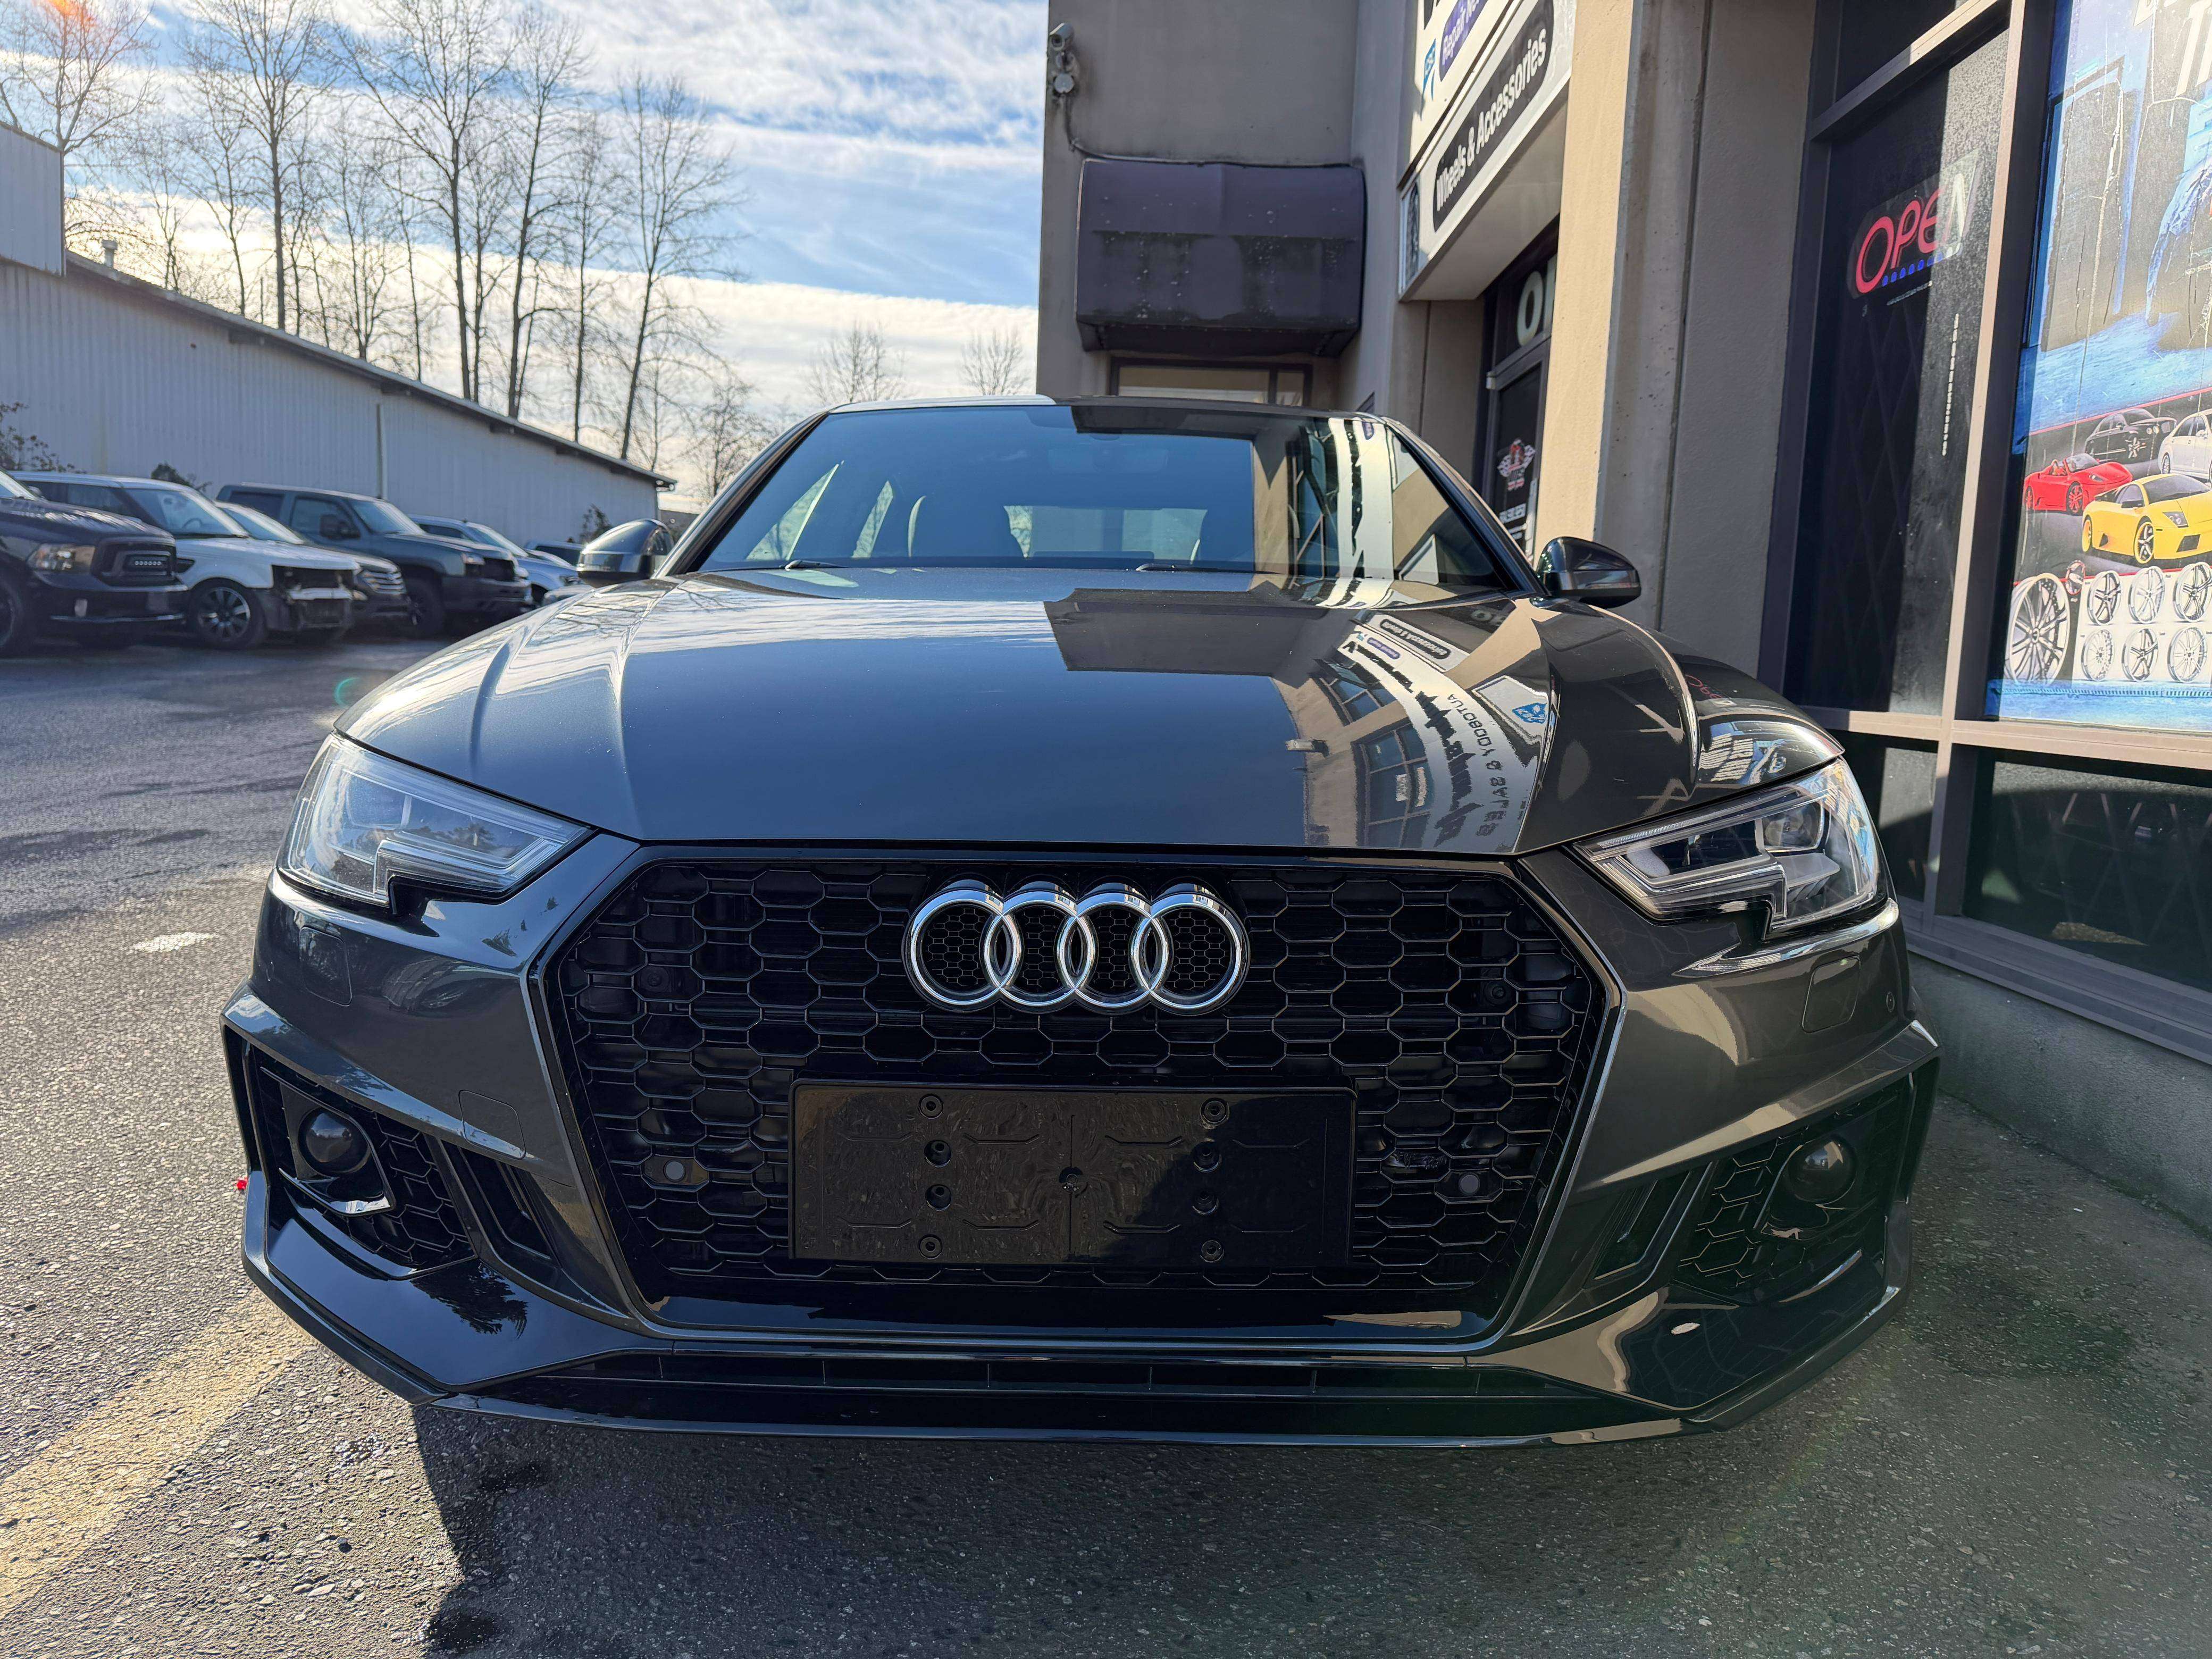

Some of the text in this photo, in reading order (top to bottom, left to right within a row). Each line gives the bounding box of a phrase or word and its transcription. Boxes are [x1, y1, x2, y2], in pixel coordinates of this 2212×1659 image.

[1437, 29, 1546, 211] Wheels & Accessories
